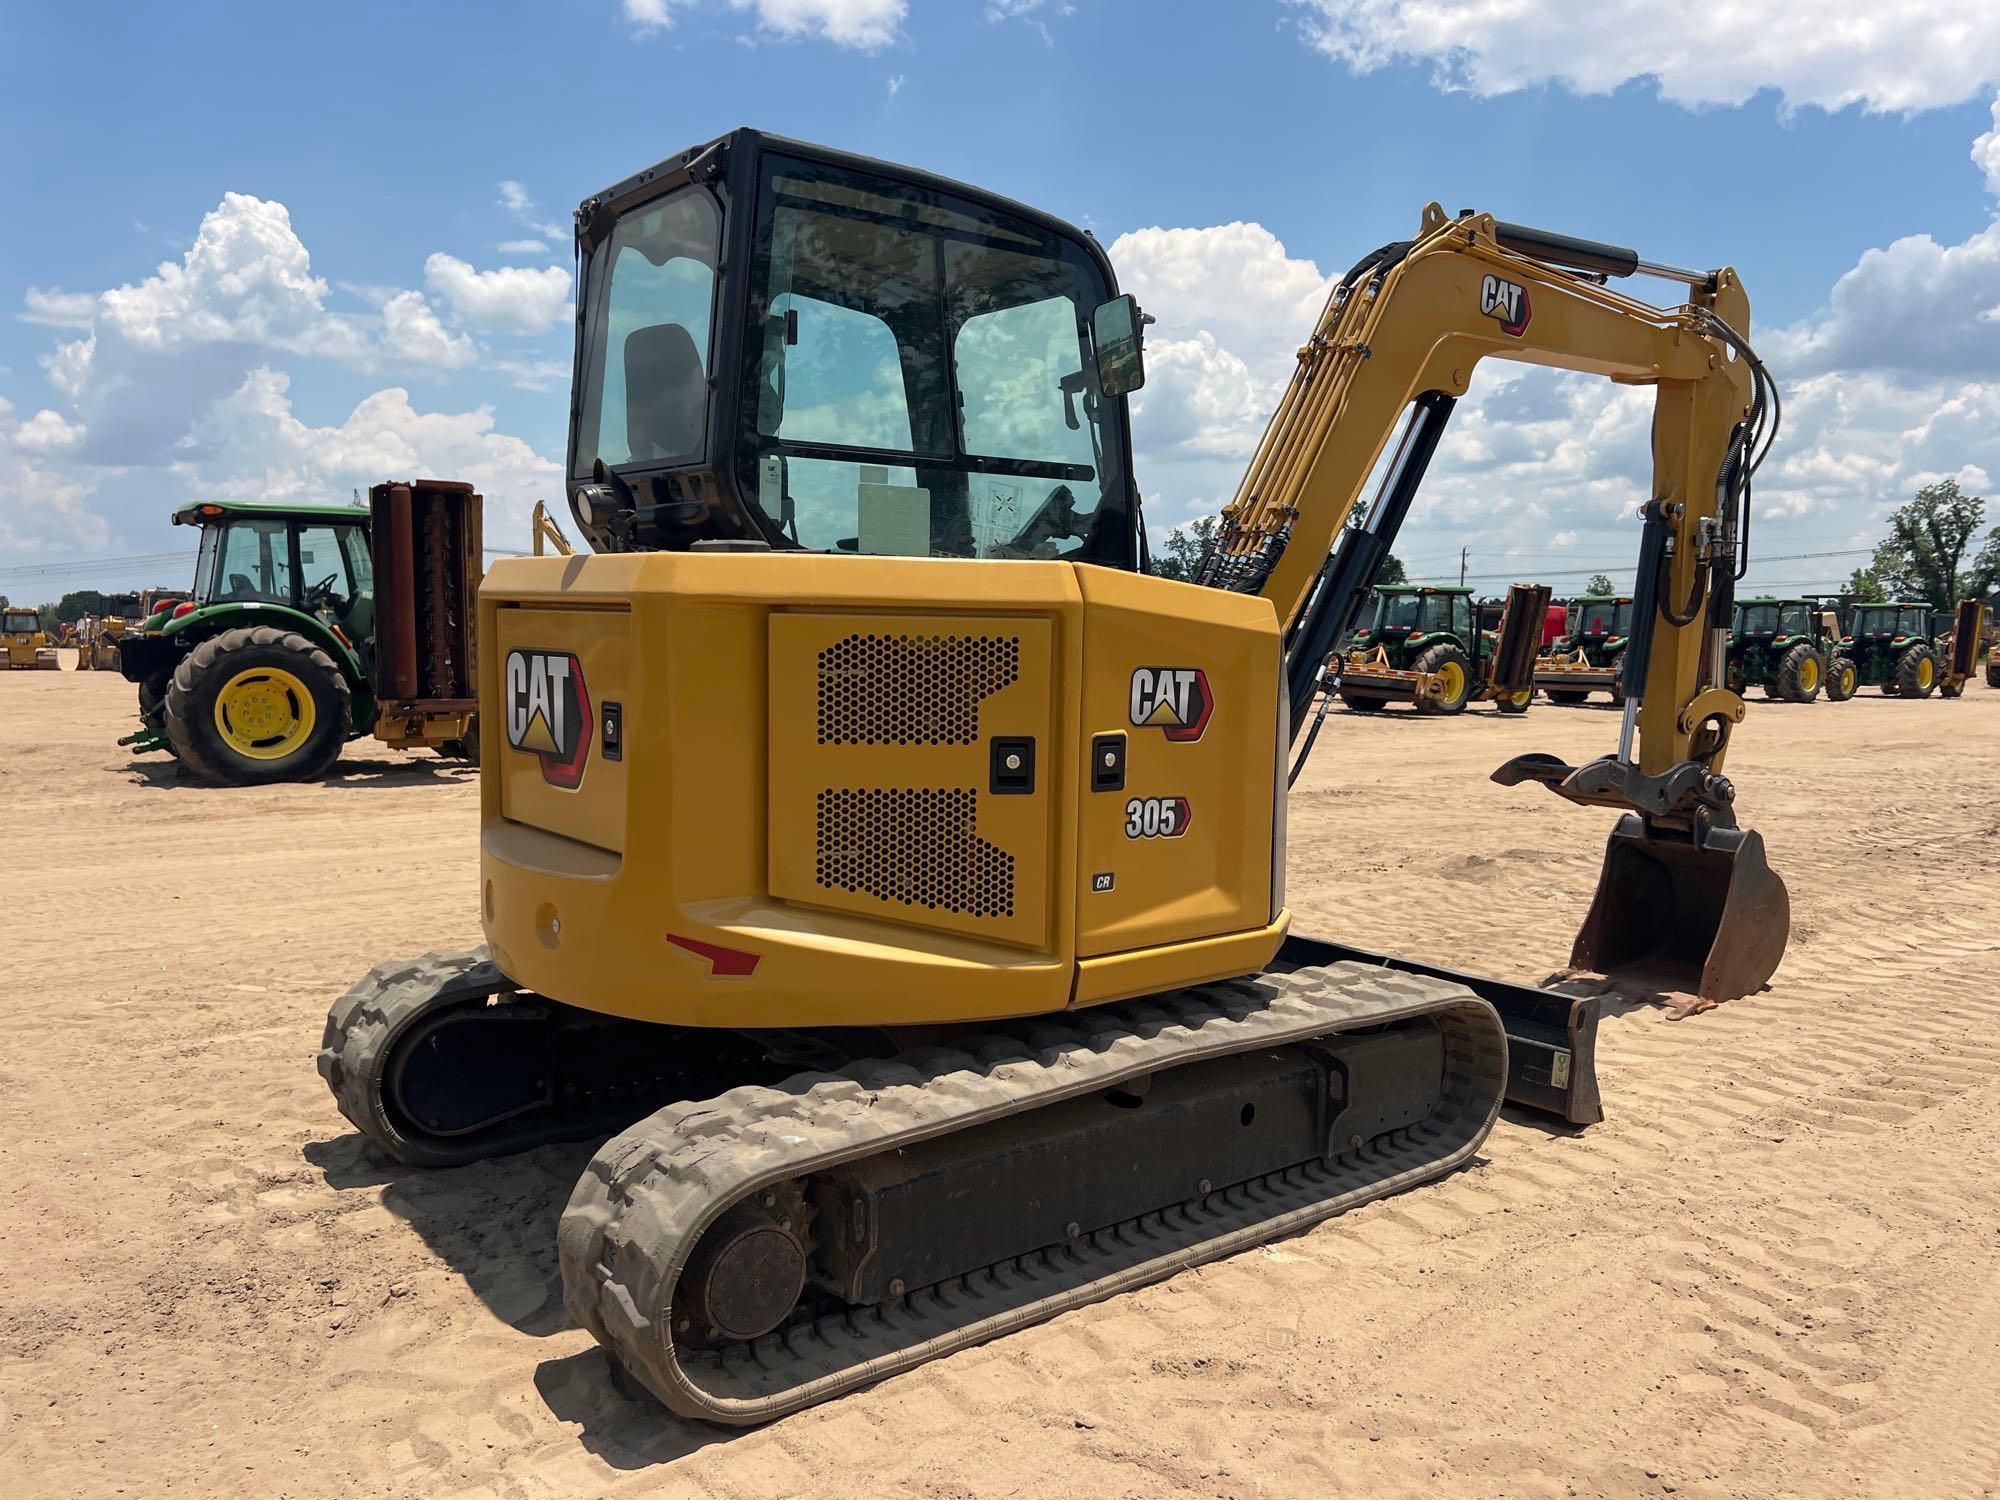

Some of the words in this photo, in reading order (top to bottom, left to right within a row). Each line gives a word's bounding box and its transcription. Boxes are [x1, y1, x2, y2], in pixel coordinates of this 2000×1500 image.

[1481, 275, 1522, 323] CAT
[507, 652, 569, 754] CAT
[1131, 668, 1195, 725] CAT
[1126, 799, 1176, 837] 305
[1096, 876, 1111, 889] CR
